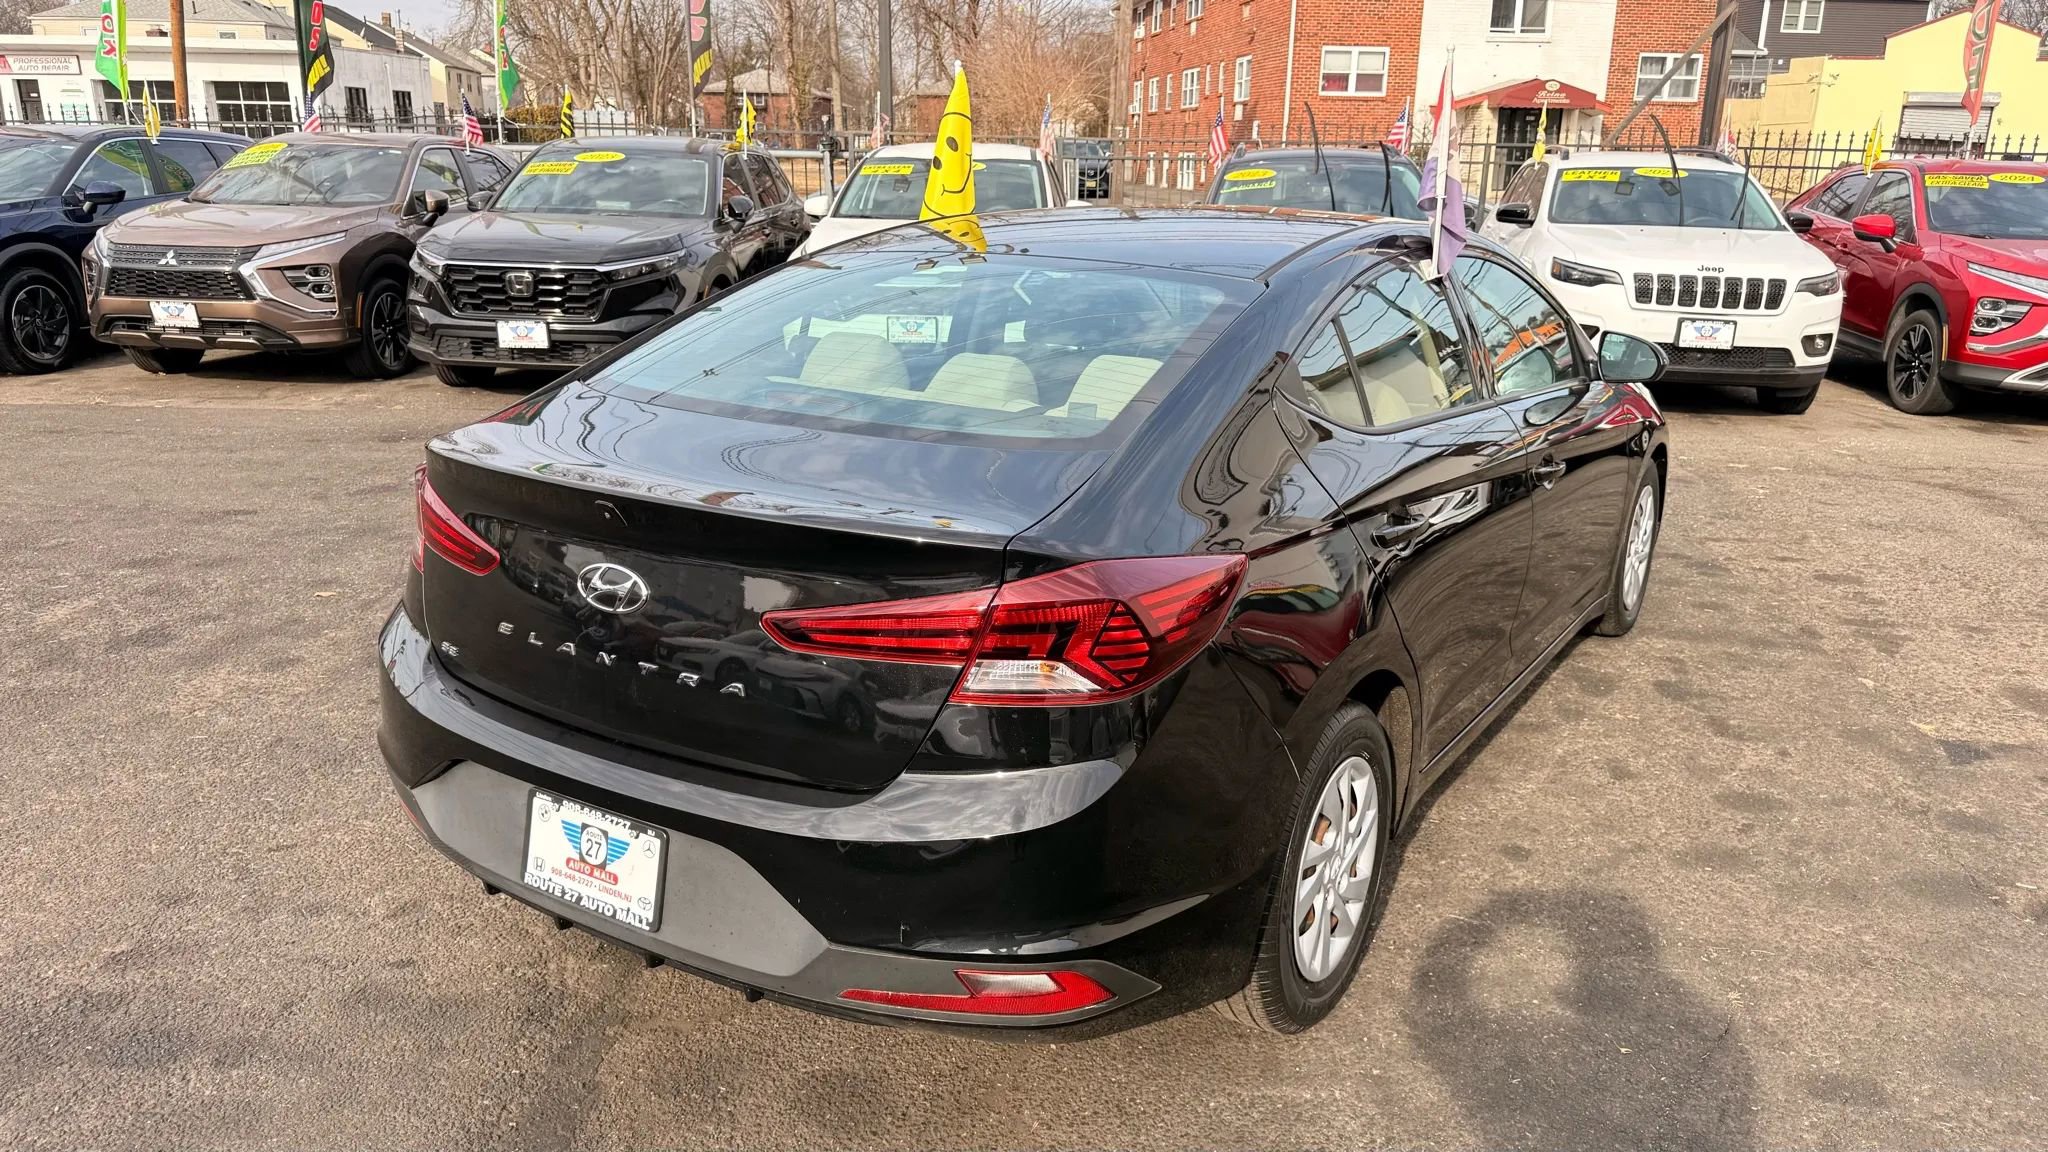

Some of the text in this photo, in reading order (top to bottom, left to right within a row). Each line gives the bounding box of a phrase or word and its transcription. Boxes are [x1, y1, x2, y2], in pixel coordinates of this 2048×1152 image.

[18, 64, 70, 72] AUTO REPAIR
[1697, 265, 1725, 274] Jeep
[441, 641, 460, 657] SE
[497, 622, 747, 697] ELANTRA
[585, 829, 603, 841] ROUTE
[585, 838, 602, 861] 27
[550, 866, 593, 888] 908-648-2727
[569, 860, 616, 884] AUTO MALL
[524, 872, 651, 931] ROUTE 27 AUTO MALL
